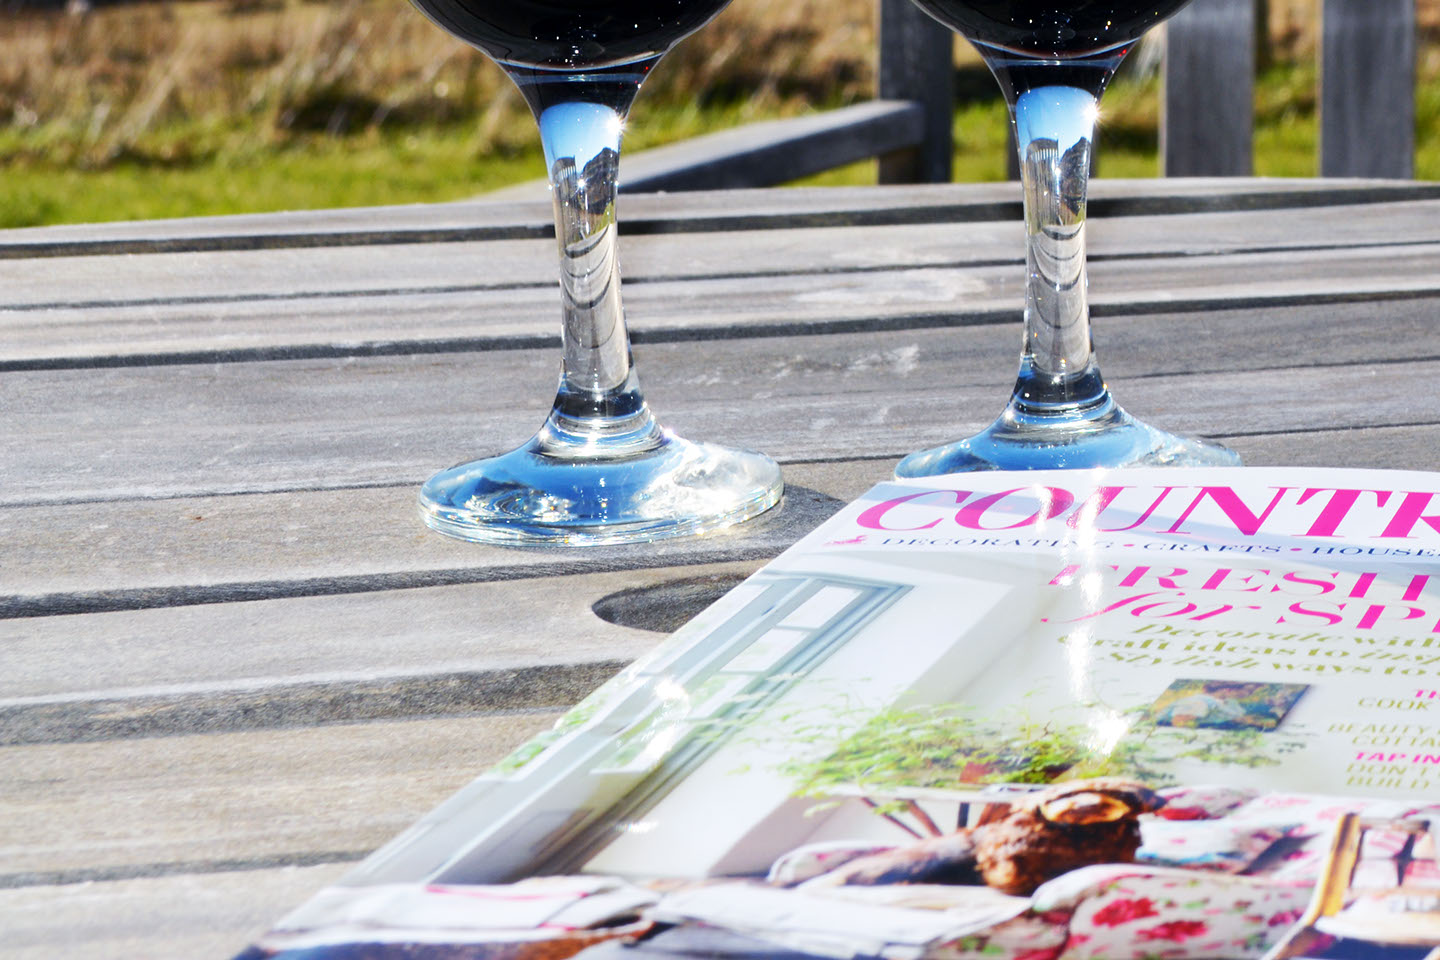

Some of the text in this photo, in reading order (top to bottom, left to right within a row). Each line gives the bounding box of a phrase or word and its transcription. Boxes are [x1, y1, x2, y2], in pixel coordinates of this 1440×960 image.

[1143, 543, 1282, 553] CRAFTS
[1047, 564, 1432, 601] FRESH
[1040, 591, 1262, 623] for
[1132, 623, 1343, 642] Decorate
[1184, 640, 1297, 655] ideas
[1307, 647, 1350, 658] to
[1271, 662, 1371, 676] ways
[1384, 666, 1427, 676] to
[1357, 697, 1432, 710] COOK
[1354, 751, 1407, 762] TAP
